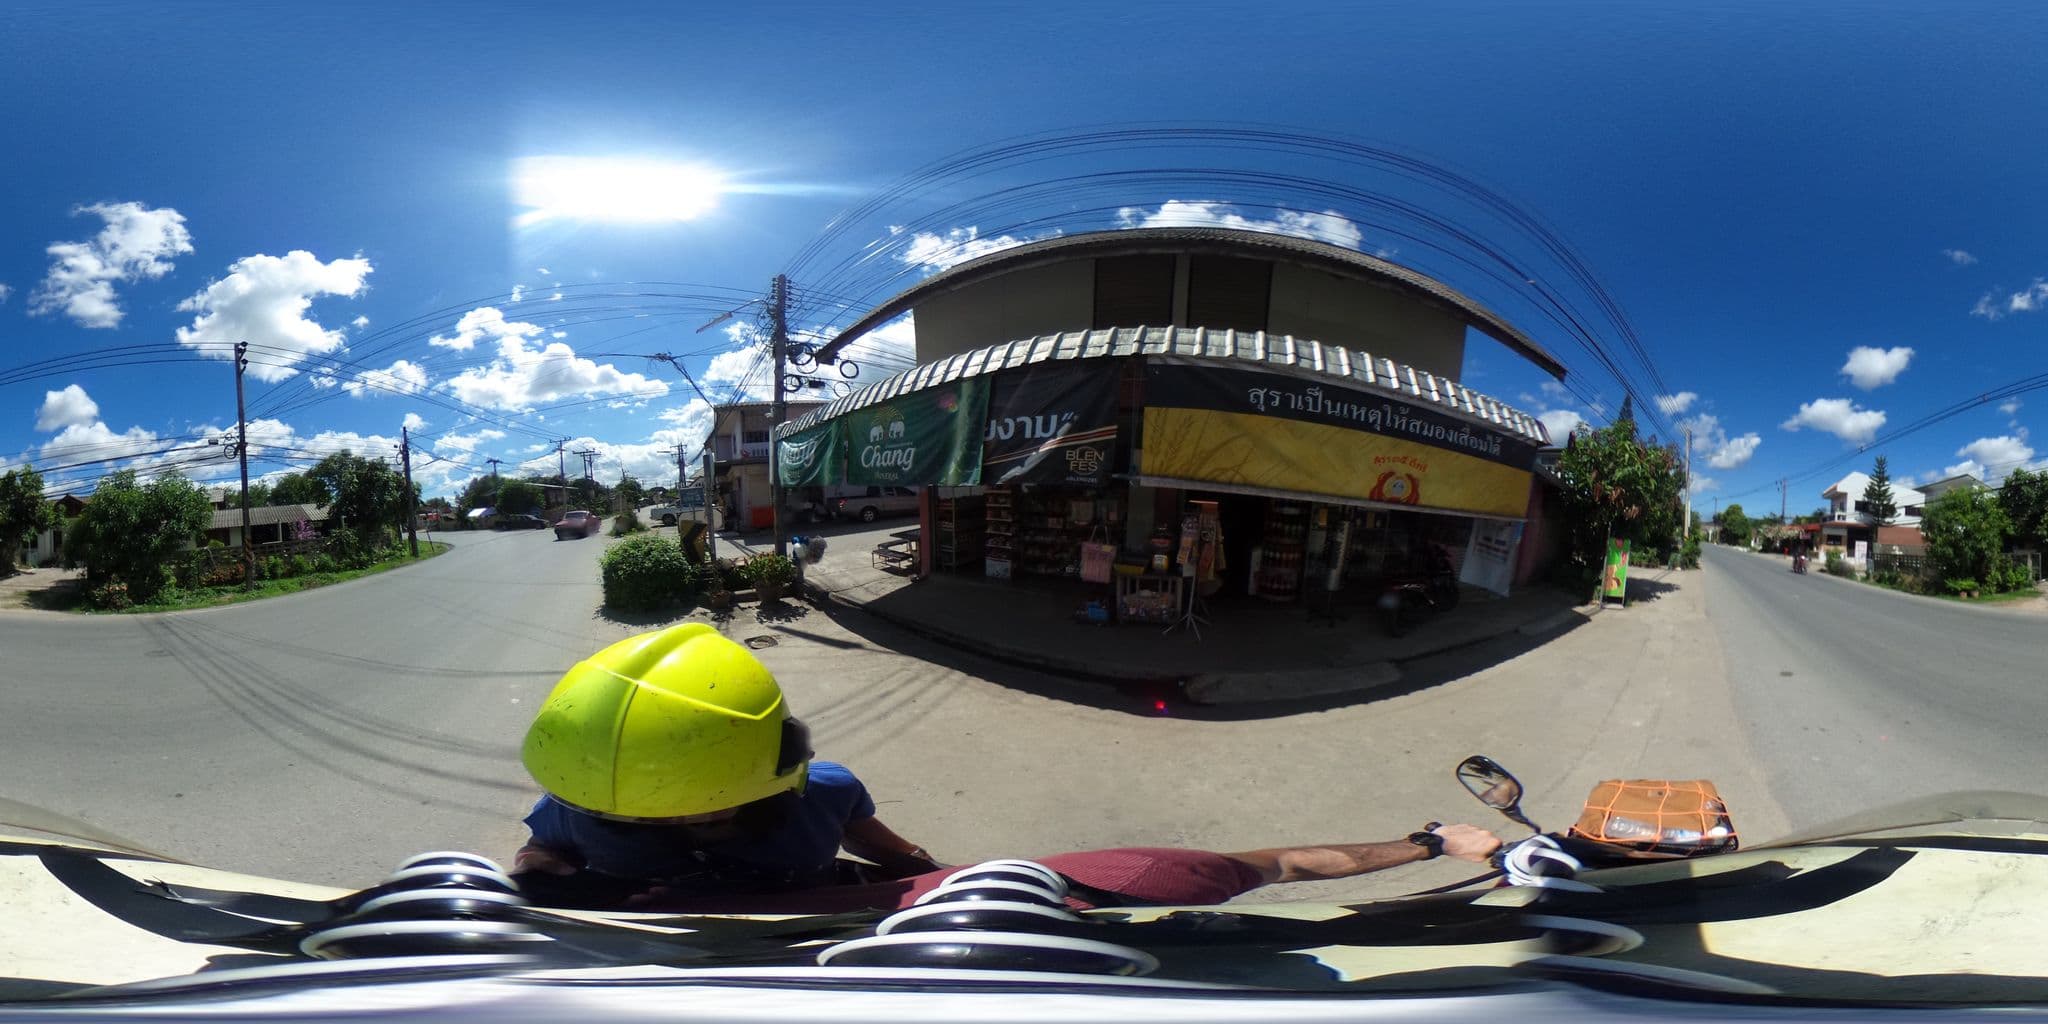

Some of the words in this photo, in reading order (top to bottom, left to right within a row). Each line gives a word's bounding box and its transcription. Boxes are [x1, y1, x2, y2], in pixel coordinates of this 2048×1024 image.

[861, 445, 915, 471] Chang
[1066, 450, 1105, 461] BLEN
[1070, 461, 1098, 473] FES
